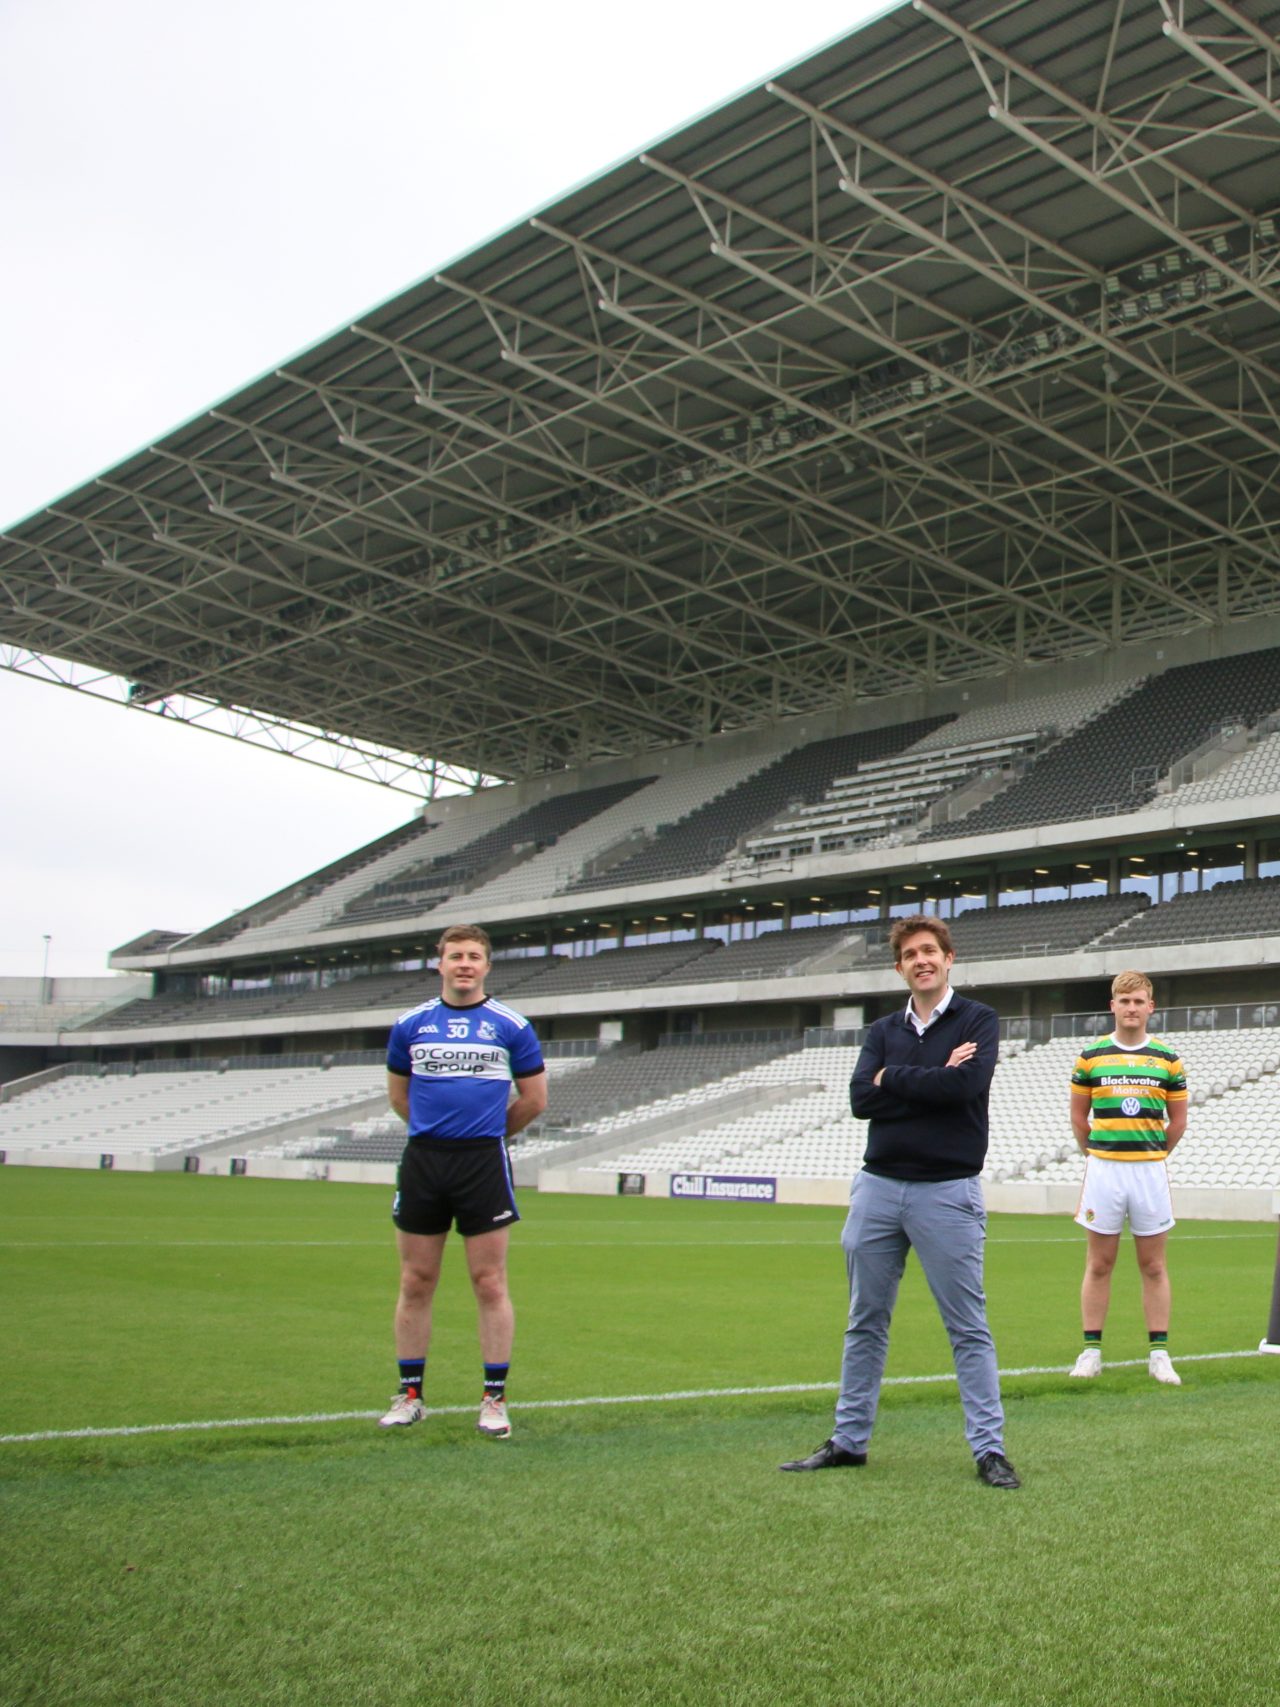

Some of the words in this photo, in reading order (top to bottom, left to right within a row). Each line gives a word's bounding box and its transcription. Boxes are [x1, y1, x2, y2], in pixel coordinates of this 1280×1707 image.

[446, 1024, 469, 1039] 30
[414, 1048, 499, 1062] O'Connell
[425, 1061, 485, 1074] Group
[1101, 1075, 1161, 1087] Blackwater
[1112, 1086, 1150, 1095] Motors
[672, 1176, 704, 1195] Chill
[706, 1177, 774, 1199] Insurance
